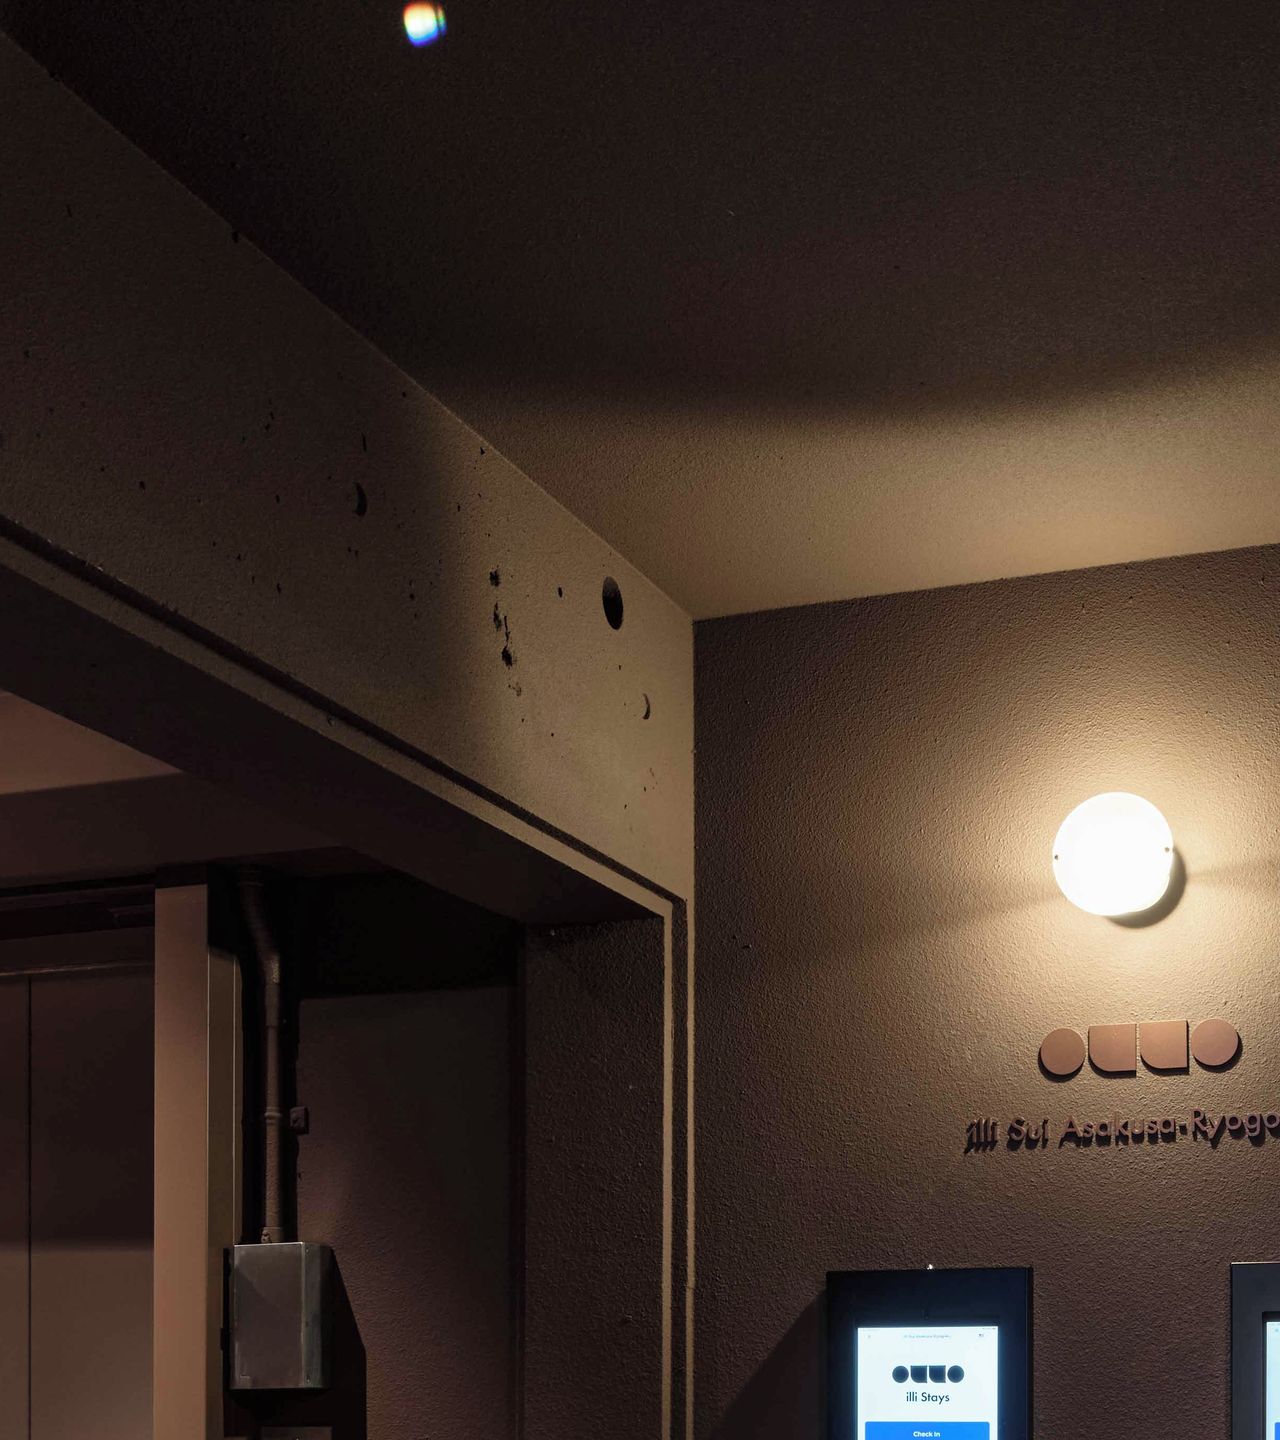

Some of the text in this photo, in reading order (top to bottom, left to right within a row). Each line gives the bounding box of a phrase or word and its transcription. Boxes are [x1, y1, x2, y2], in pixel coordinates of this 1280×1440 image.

[1010, 1115, 1050, 1144] Sui
[906, 1391, 950, 1405] illi Stays
